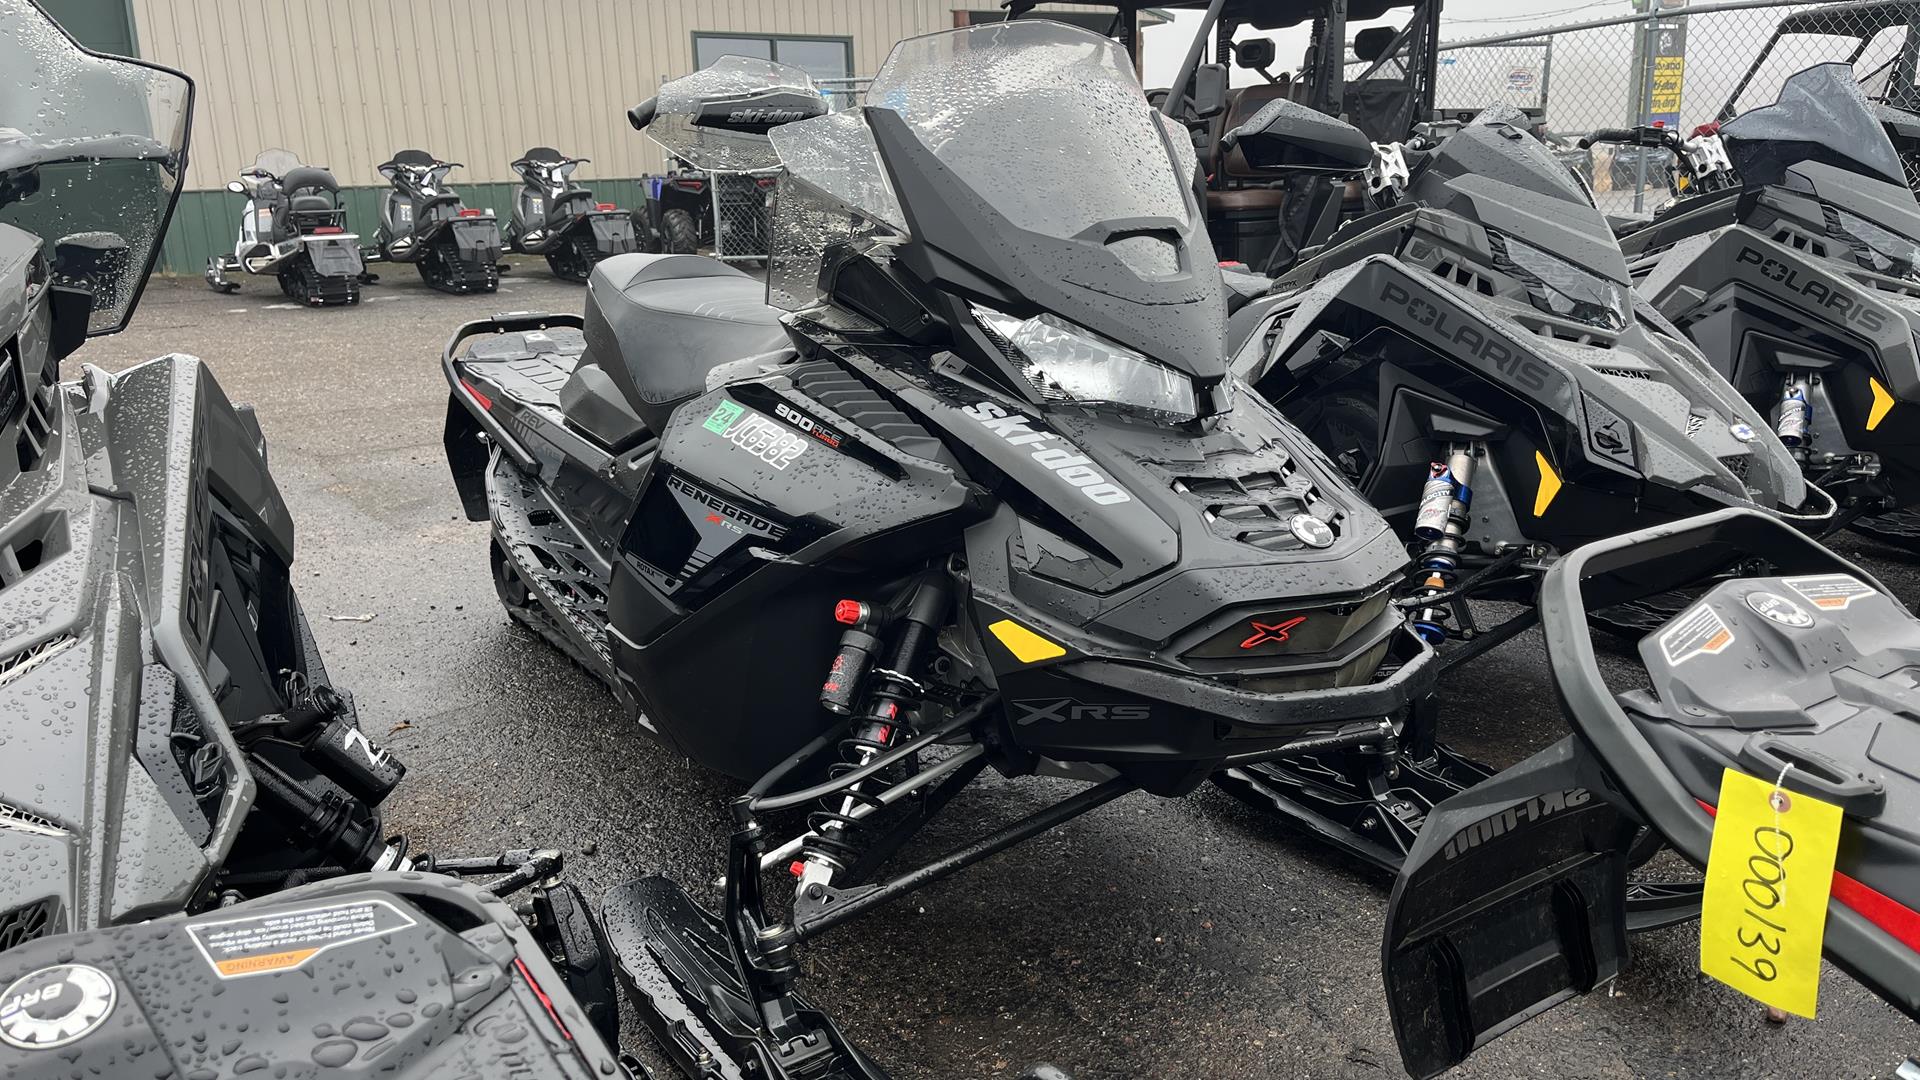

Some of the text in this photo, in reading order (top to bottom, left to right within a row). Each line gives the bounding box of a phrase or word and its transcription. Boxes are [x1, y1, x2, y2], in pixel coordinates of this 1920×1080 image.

[728, 109, 804, 123] ski-doo
[1735, 246, 1887, 333] POLARIS
[1379, 281, 1550, 392] POLARIS
[520, 410, 546, 430] REV
[714, 408, 734, 425] 24
[775, 403, 814, 432] 900
[962, 402, 1131, 506] ski-doo
[667, 476, 788, 541] RENEGADE
[705, 512, 744, 535] XRS
[636, 560, 656, 579] ROTAX
[1012, 699, 1151, 727] XRS
[1730, 826, 1794, 982] 000139
[0, 982, 63, 1017] BRP
